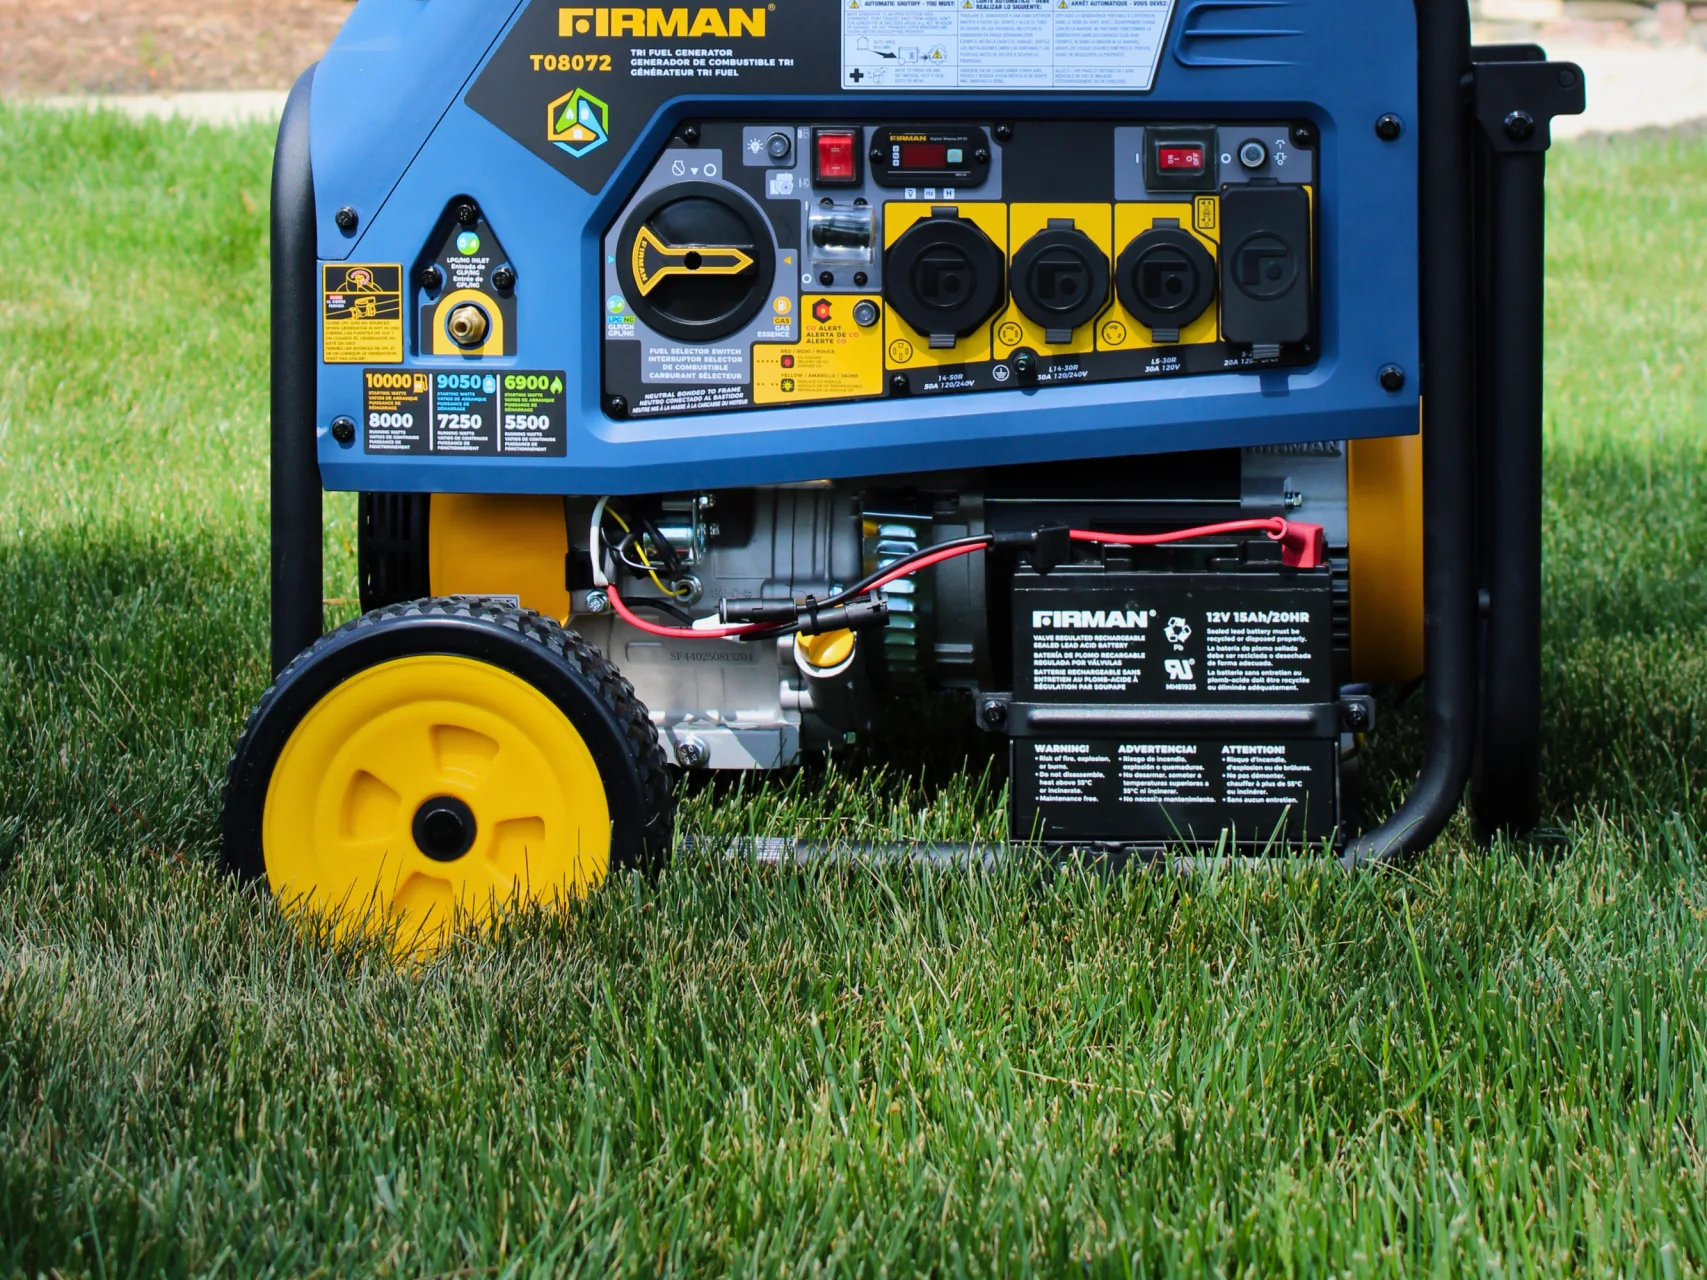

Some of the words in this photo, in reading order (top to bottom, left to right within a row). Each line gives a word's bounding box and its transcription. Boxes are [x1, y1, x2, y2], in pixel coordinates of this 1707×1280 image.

[558, 8, 766, 37] FIRMAN
[530, 54, 612, 72] T08072
[631, 68, 694, 76] GÉNÉRATEUR
[638, 240, 648, 282] FIRMAN
[366, 374, 411, 388] 10000
[1054, 371, 1088, 379] 120/240V
[437, 375, 480, 389] 9050
[504, 376, 549, 389] 6900
[941, 380, 974, 388] 120/240V
[666, 396, 703, 404] CONECTADO
[369, 413, 413, 428] 8000
[437, 414, 482, 429] 7250
[505, 415, 549, 430] 5500
[1033, 611, 1148, 628] FIRMAN
[1206, 612, 1230, 622] 12V
[1233, 611, 1309, 624] 15Ah/20HR
[1034, 744, 1089, 753] WARNING!
[1118, 745, 1197, 753] ADVERTENCIA!
[1222, 745, 1286, 754] ATTENTION!
